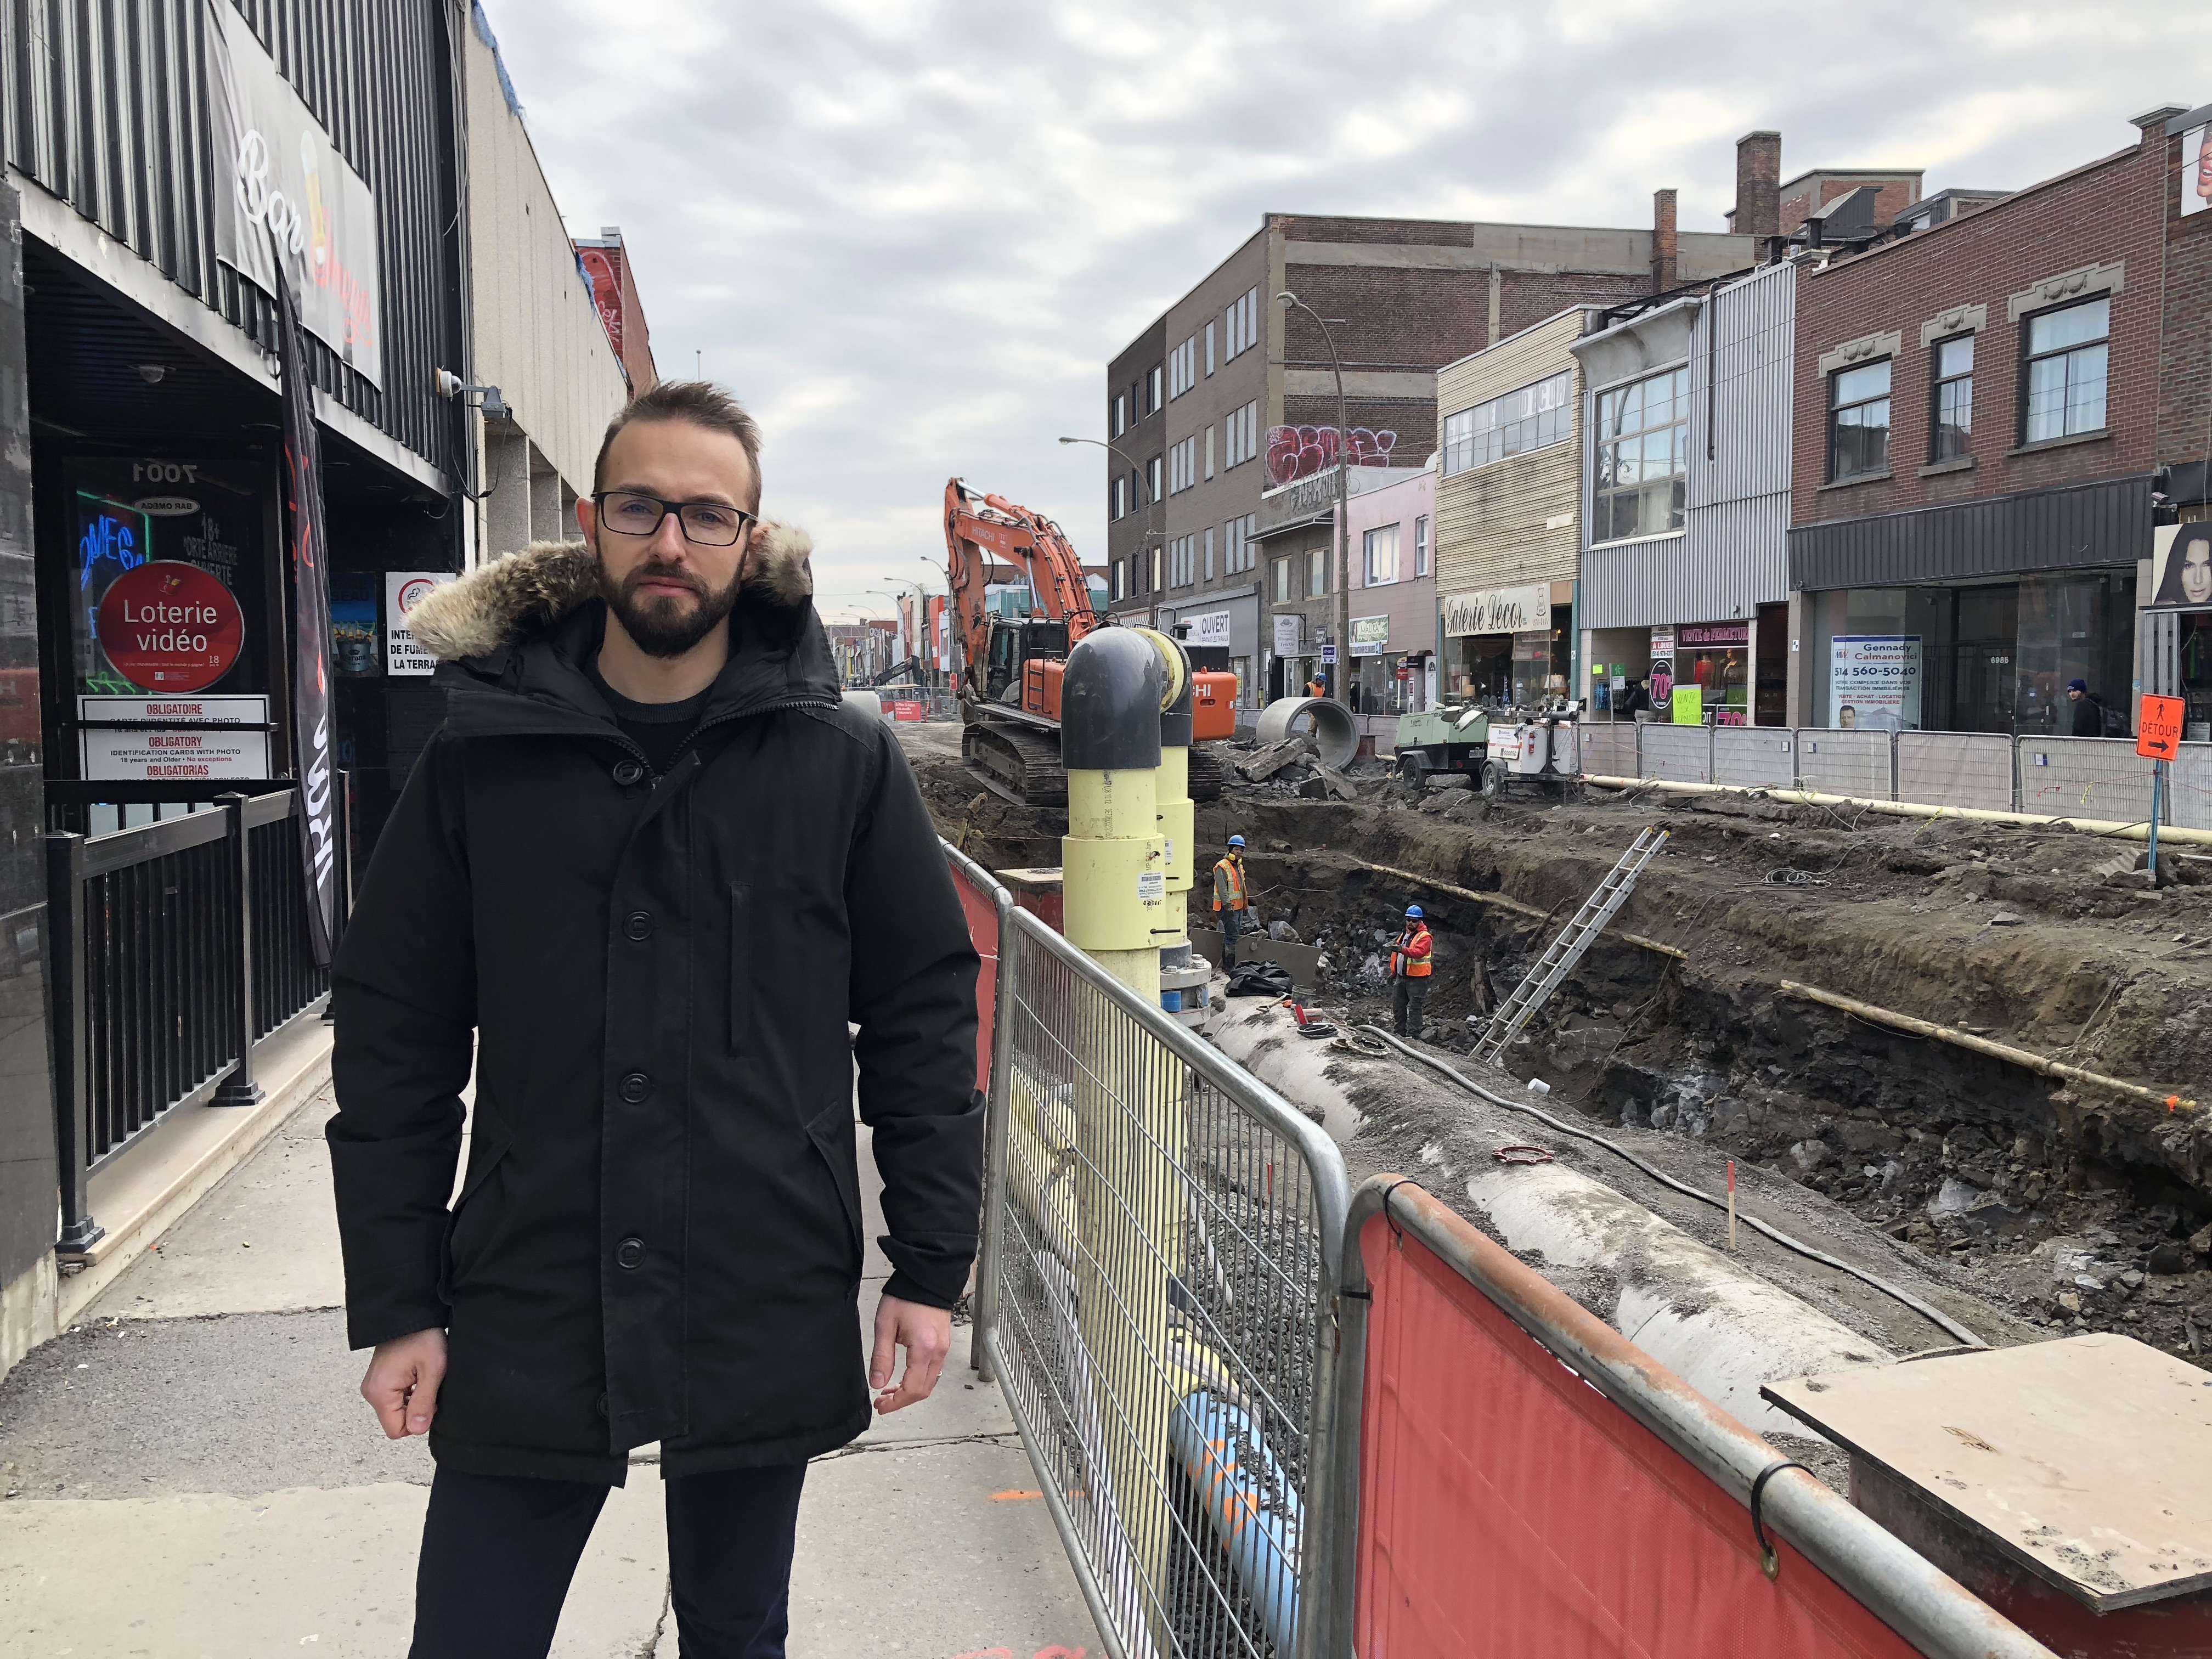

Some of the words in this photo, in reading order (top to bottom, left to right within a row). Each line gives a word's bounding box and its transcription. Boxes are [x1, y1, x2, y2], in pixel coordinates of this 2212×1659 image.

[236, 129, 304, 255] Bar
[972, 526, 995, 542] HITACHI
[124, 599, 217, 624] Loterie
[1446, 596, 1485, 634] Galerie
[1488, 594, 1522, 630] Décor
[1201, 614, 1229, 635] OUVERT
[136, 628, 208, 652] vidéo
[1681, 629, 1703, 642] VENTE
[1711, 627, 1748, 641] FERMETUR
[390, 645, 402, 654] DE
[404, 645, 428, 654] FUME
[1863, 644, 1911, 652] Gennady
[394, 659, 405, 669] LA
[407, 659, 436, 669] TERRA
[1835, 667, 1849, 676] 514
[1852, 666, 1916, 676] 560-5040
[1651, 673, 1672, 699] 70%
[146, 704, 202, 714] OBLIGATOIRE
[2142, 720, 2179, 738] DÉTOUR
[149, 736, 202, 747] OBLIGATORY
[146, 765, 209, 776] OBLIGATORIAS
